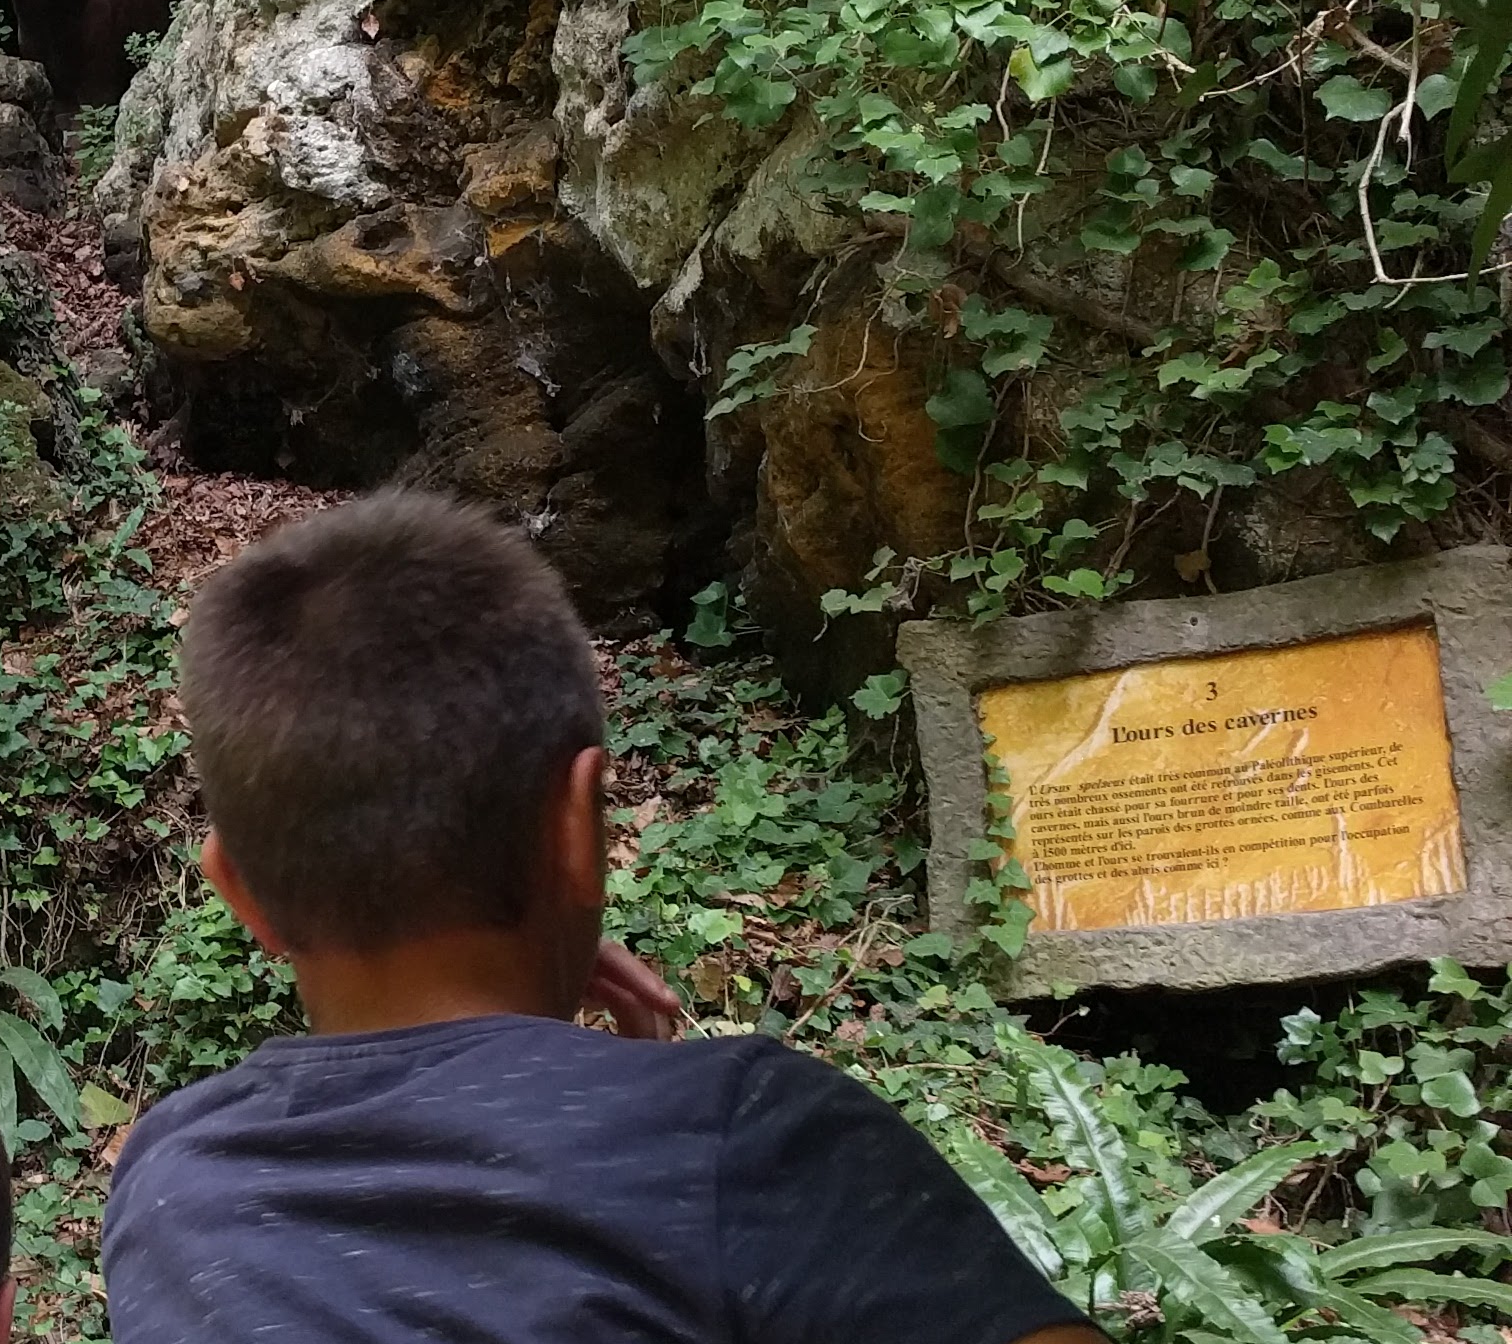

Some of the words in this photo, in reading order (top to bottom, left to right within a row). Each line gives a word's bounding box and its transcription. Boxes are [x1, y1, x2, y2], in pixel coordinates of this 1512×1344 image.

[1206, 682, 1218, 700] 3
[1112, 725, 1174, 744] L'ours
[1182, 719, 1217, 735] des
[1225, 706, 1317, 730] cavernes
[1030, 798, 1050, 807] très
[1054, 791, 1108, 805] nombreux
[1112, 787, 1166, 799] ossements
[1170, 784, 1187, 793] ont
[1191, 780, 1207, 791] été
[1211, 775, 1262, 789] retrouvés
[1267, 769, 1293, 782] dans
[1297, 768, 1312, 777] les
[1378, 757, 1397, 767] Cet
[1129, 774, 1153, 785] était
[1158, 772, 1179, 782] très
[1183, 766, 1230, 779] commun
[1235, 764, 1248, 773] au
[1252, 756, 1324, 771] Paléolithique
[1389, 742, 1403, 752] de
[1030, 810, 1054, 820] ours
[1057, 807, 1081, 818] était
[1086, 802, 1120, 815] chassé
[1125, 800, 1153, 813] pour
[1170, 794, 1219, 806] fourrure
[1223, 791, 1232, 800] et
[1237, 787, 1262, 802] pour
[1267, 787, 1284, 795] ses
[1324, 777, 1356, 788] L'ours
[1360, 773, 1379, 783] des
[1084, 819, 1109, 828] mais
[1113, 816, 1140, 826] aussi
[1144, 811, 1173, 823] l'ours
[1177, 808, 1205, 819] brun
[1209, 806, 1221, 816] de
[1225, 800, 1271, 813] moindre
[1275, 796, 1308, 807] taille,
[1311, 794, 1329, 803] ont
[1333, 790, 1349, 800] été
[1353, 785, 1394, 800] parfois
[1032, 834, 1093, 848] représentés
[1097, 832, 1113, 840] sur
[1118, 828, 1133, 838] les
[1136, 824, 1170, 837] parois
[1174, 821, 1191, 833] des
[1195, 819, 1234, 832] grottes
[1281, 809, 1321, 820] comme
[1326, 806, 1346, 815] aux
[1350, 795, 1424, 812] Combarelles
[1032, 849, 1039, 858] à
[1043, 847, 1066, 857] 1500
[1071, 844, 1107, 855] mètres
[1111, 841, 1136, 851] d'ici.
[1034, 861, 1081, 871] L'homme
[1085, 858, 1095, 867] et
[1098, 854, 1128, 866] l'ours
[1146, 845, 1219, 861] trouvaient-ils
[1223, 845, 1235, 854] en
[1239, 836, 1305, 852] compétition
[1310, 834, 1337, 847] pour
[1341, 825, 1409, 840] l'occupation
[1035, 875, 1052, 884] des
[1056, 871, 1094, 884] grottes
[1097, 869, 1108, 878] et
[1111, 866, 1128, 877] des
[1132, 863, 1160, 876] abris
[1164, 863, 1203, 873] comme
[1207, 859, 1219, 868] ici
[1222, 858, 1228, 867] ?
